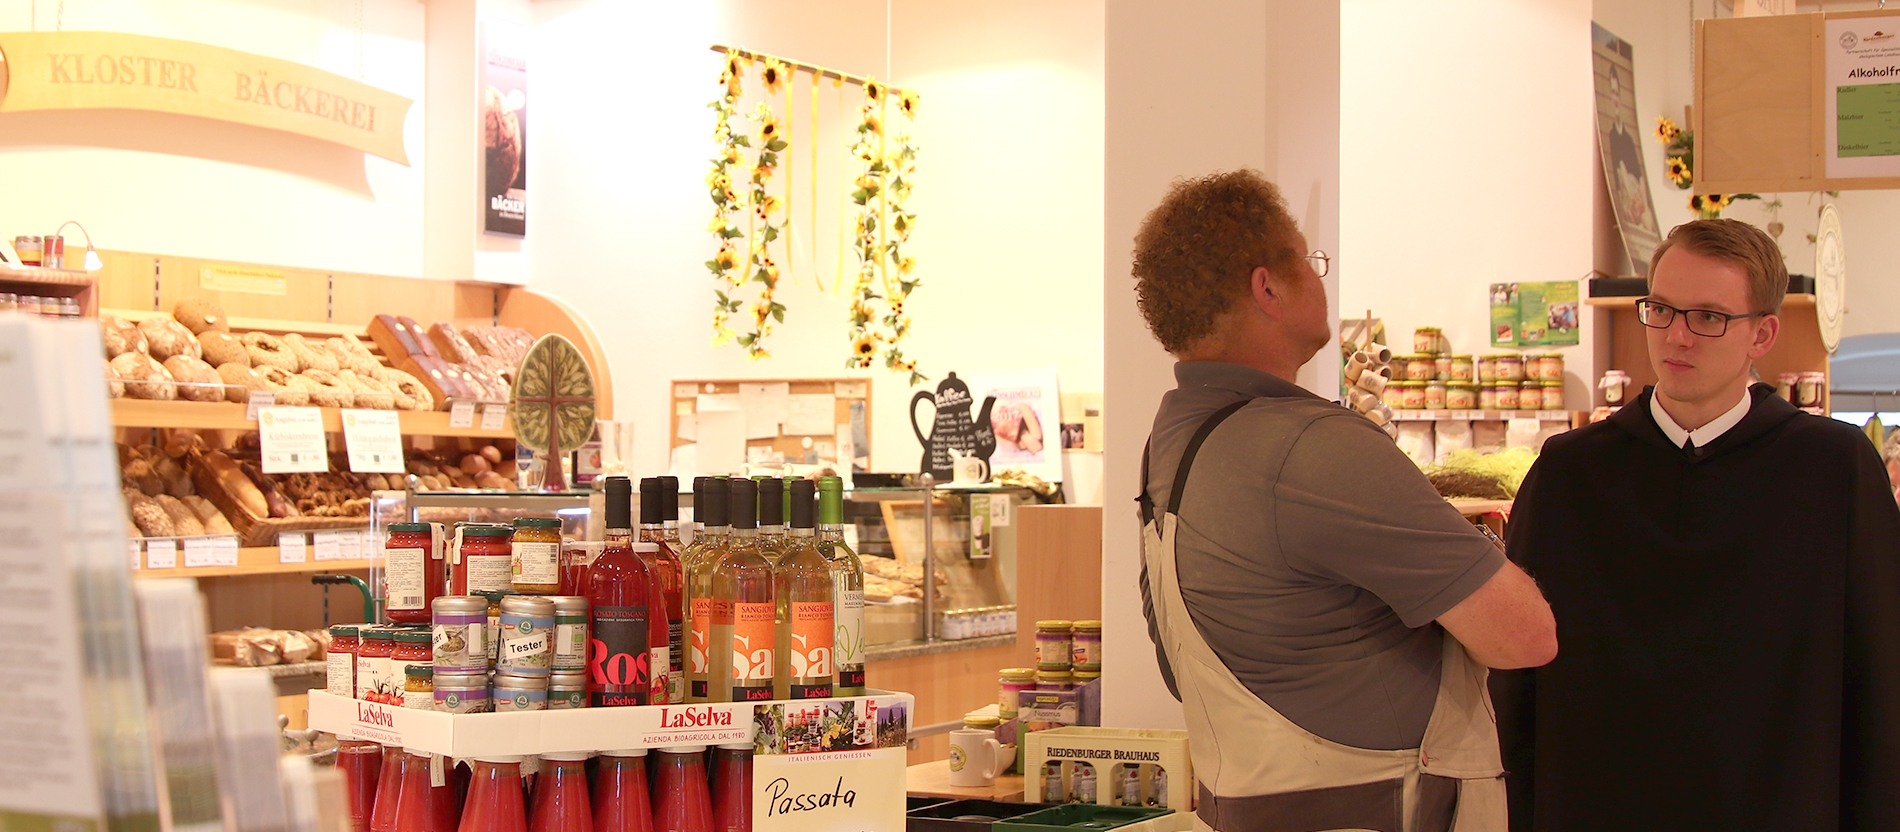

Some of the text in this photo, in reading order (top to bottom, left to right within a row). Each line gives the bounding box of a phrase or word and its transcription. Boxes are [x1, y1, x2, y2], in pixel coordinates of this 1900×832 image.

[47, 53, 377, 133] KLOSTER BÄCKEREI
[491, 194, 525, 213] BÄCKER
[510, 640, 543, 653] Tester
[602, 695, 637, 705] LaSelva
[357, 702, 394, 728] LaSelva
[660, 706, 732, 728] LaSelva
[1034, 710, 1061, 718] Nussmus
[643, 731, 746, 744] AZIENDA BIOAGRICOLA DAL 1980
[788, 752, 872, 763] ITALIENISCH GENIESSEN
[1047, 747, 1160, 761] RIEDENBURGER BRAUHAUS
[765, 776, 857, 818] Passata
